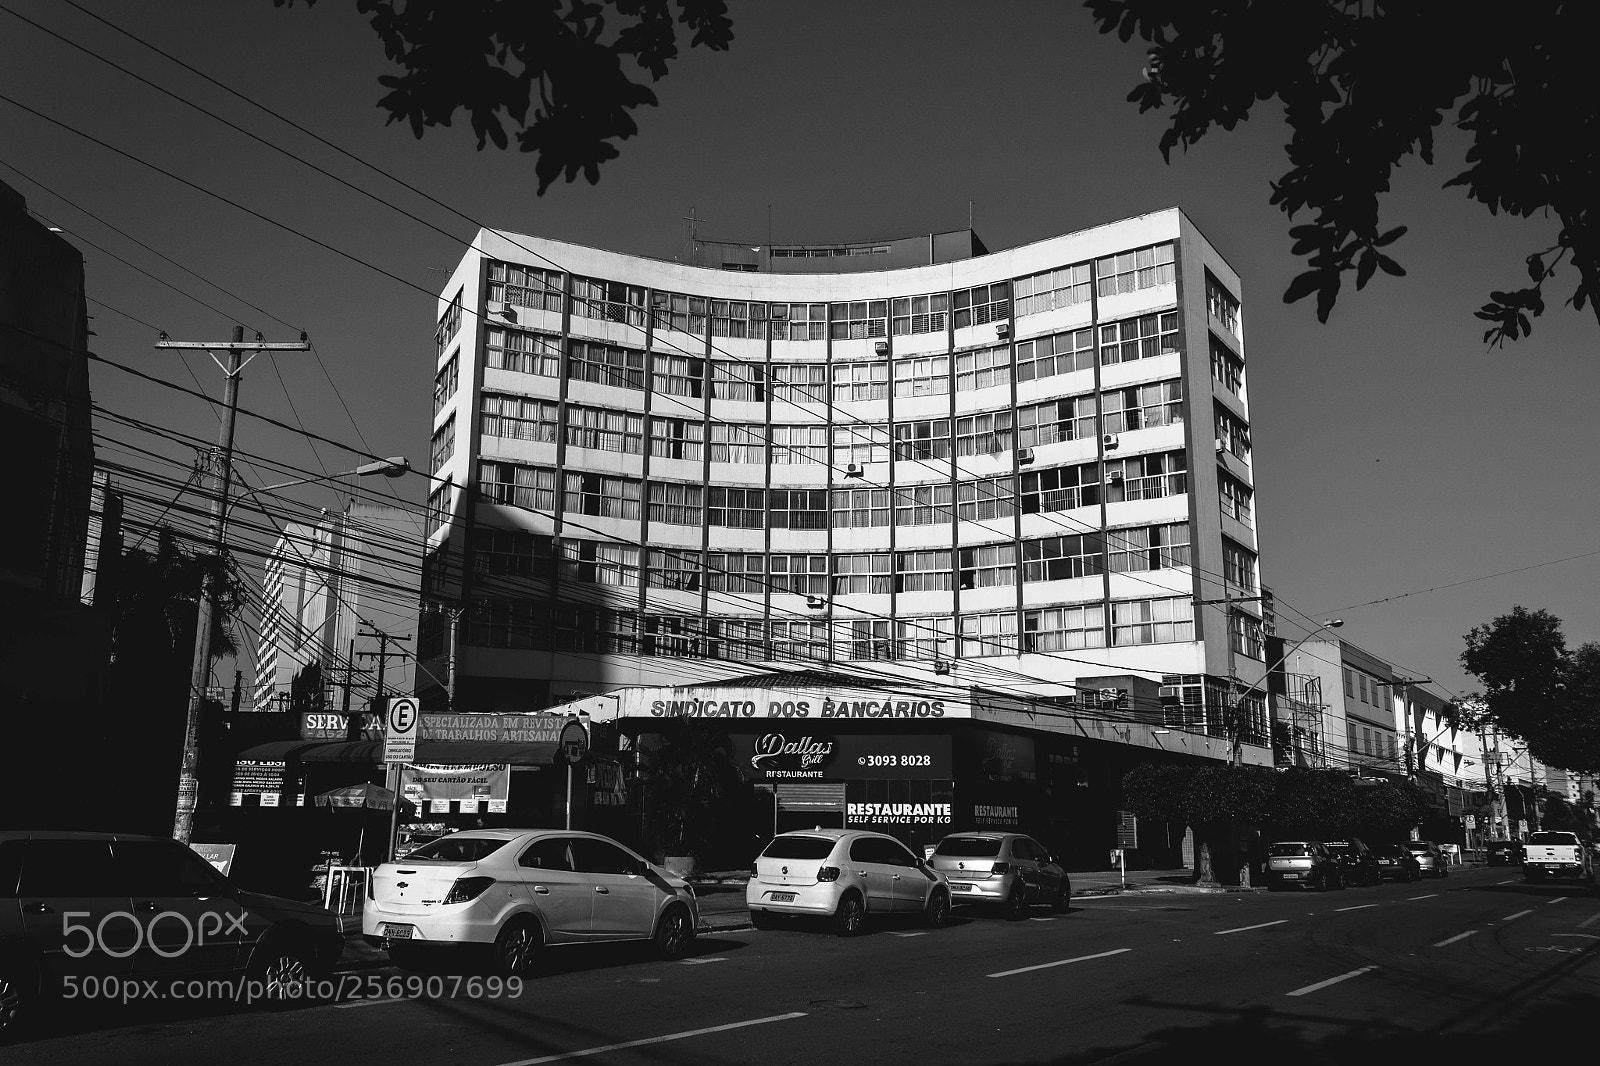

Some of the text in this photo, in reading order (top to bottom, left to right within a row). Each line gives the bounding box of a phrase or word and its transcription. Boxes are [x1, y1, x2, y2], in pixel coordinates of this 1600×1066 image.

[651, 697, 945, 718] SINDICATO DOS BANCÁRIOS
[398, 706, 409, 726] E
[503, 717, 518, 729] EM
[435, 729, 497, 741] TRABALHOS
[752, 733, 834, 762] Dallas
[801, 753, 824, 770] Grill
[867, 755, 931, 767] 3093 8028
[438, 776, 466, 784] CARTÃO
[766, 770, 824, 779] RESTAURANTE
[847, 803, 951, 816] RESTAURANTE
[974, 804, 1018, 817] RESTAURANTE
[848, 815, 951, 824] SELF SERVICE POR KG
